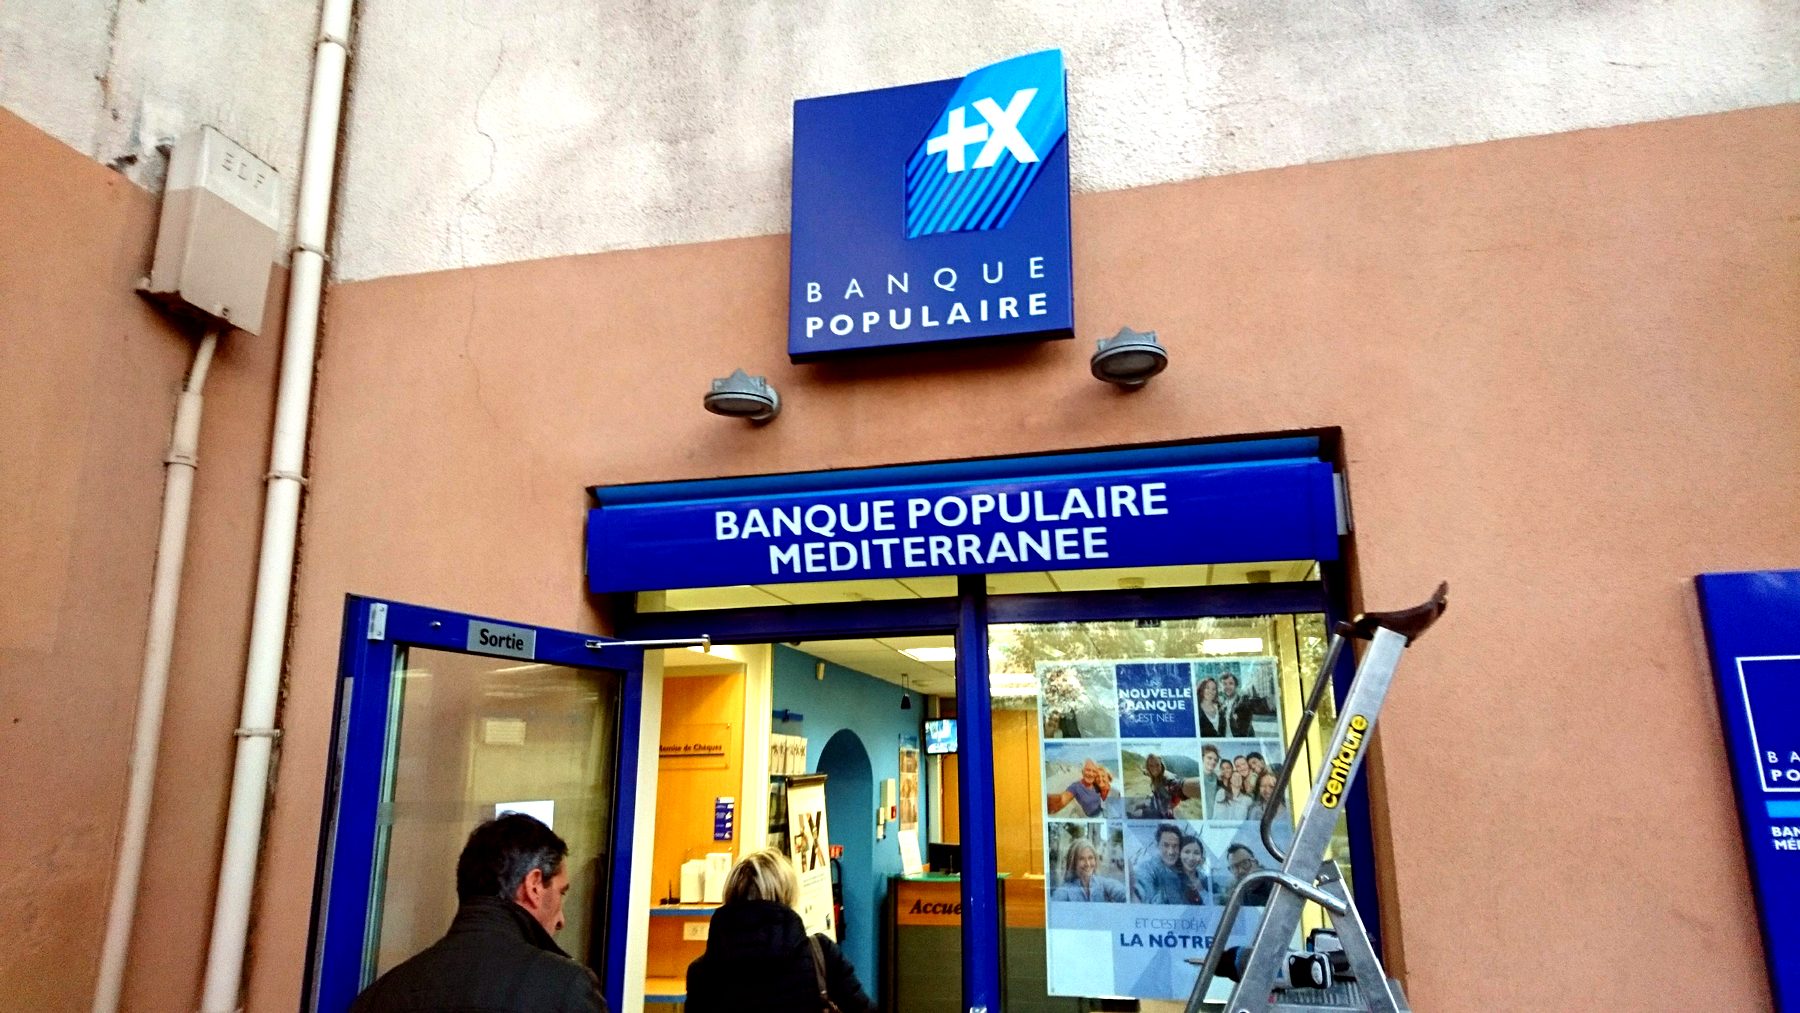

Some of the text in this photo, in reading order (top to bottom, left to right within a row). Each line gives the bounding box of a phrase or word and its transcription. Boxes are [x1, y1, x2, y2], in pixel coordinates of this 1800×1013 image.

[806, 256, 1045, 303] BANQUE
[806, 292, 1048, 338] POPULAIRE
[715, 482, 1169, 541] BANQUE POPULAIRE
[769, 526, 1110, 575] MEDITERRANEE
[480, 628, 523, 651] Sortie
[1119, 688, 1192, 699] NOUVELLE
[1126, 700, 1186, 713] BANQUE
[1156, 711, 1176, 723] NÉE
[1321, 714, 1369, 810] centaure
[1135, 918, 1148, 929] ET
[1120, 933, 1143, 947] LA
